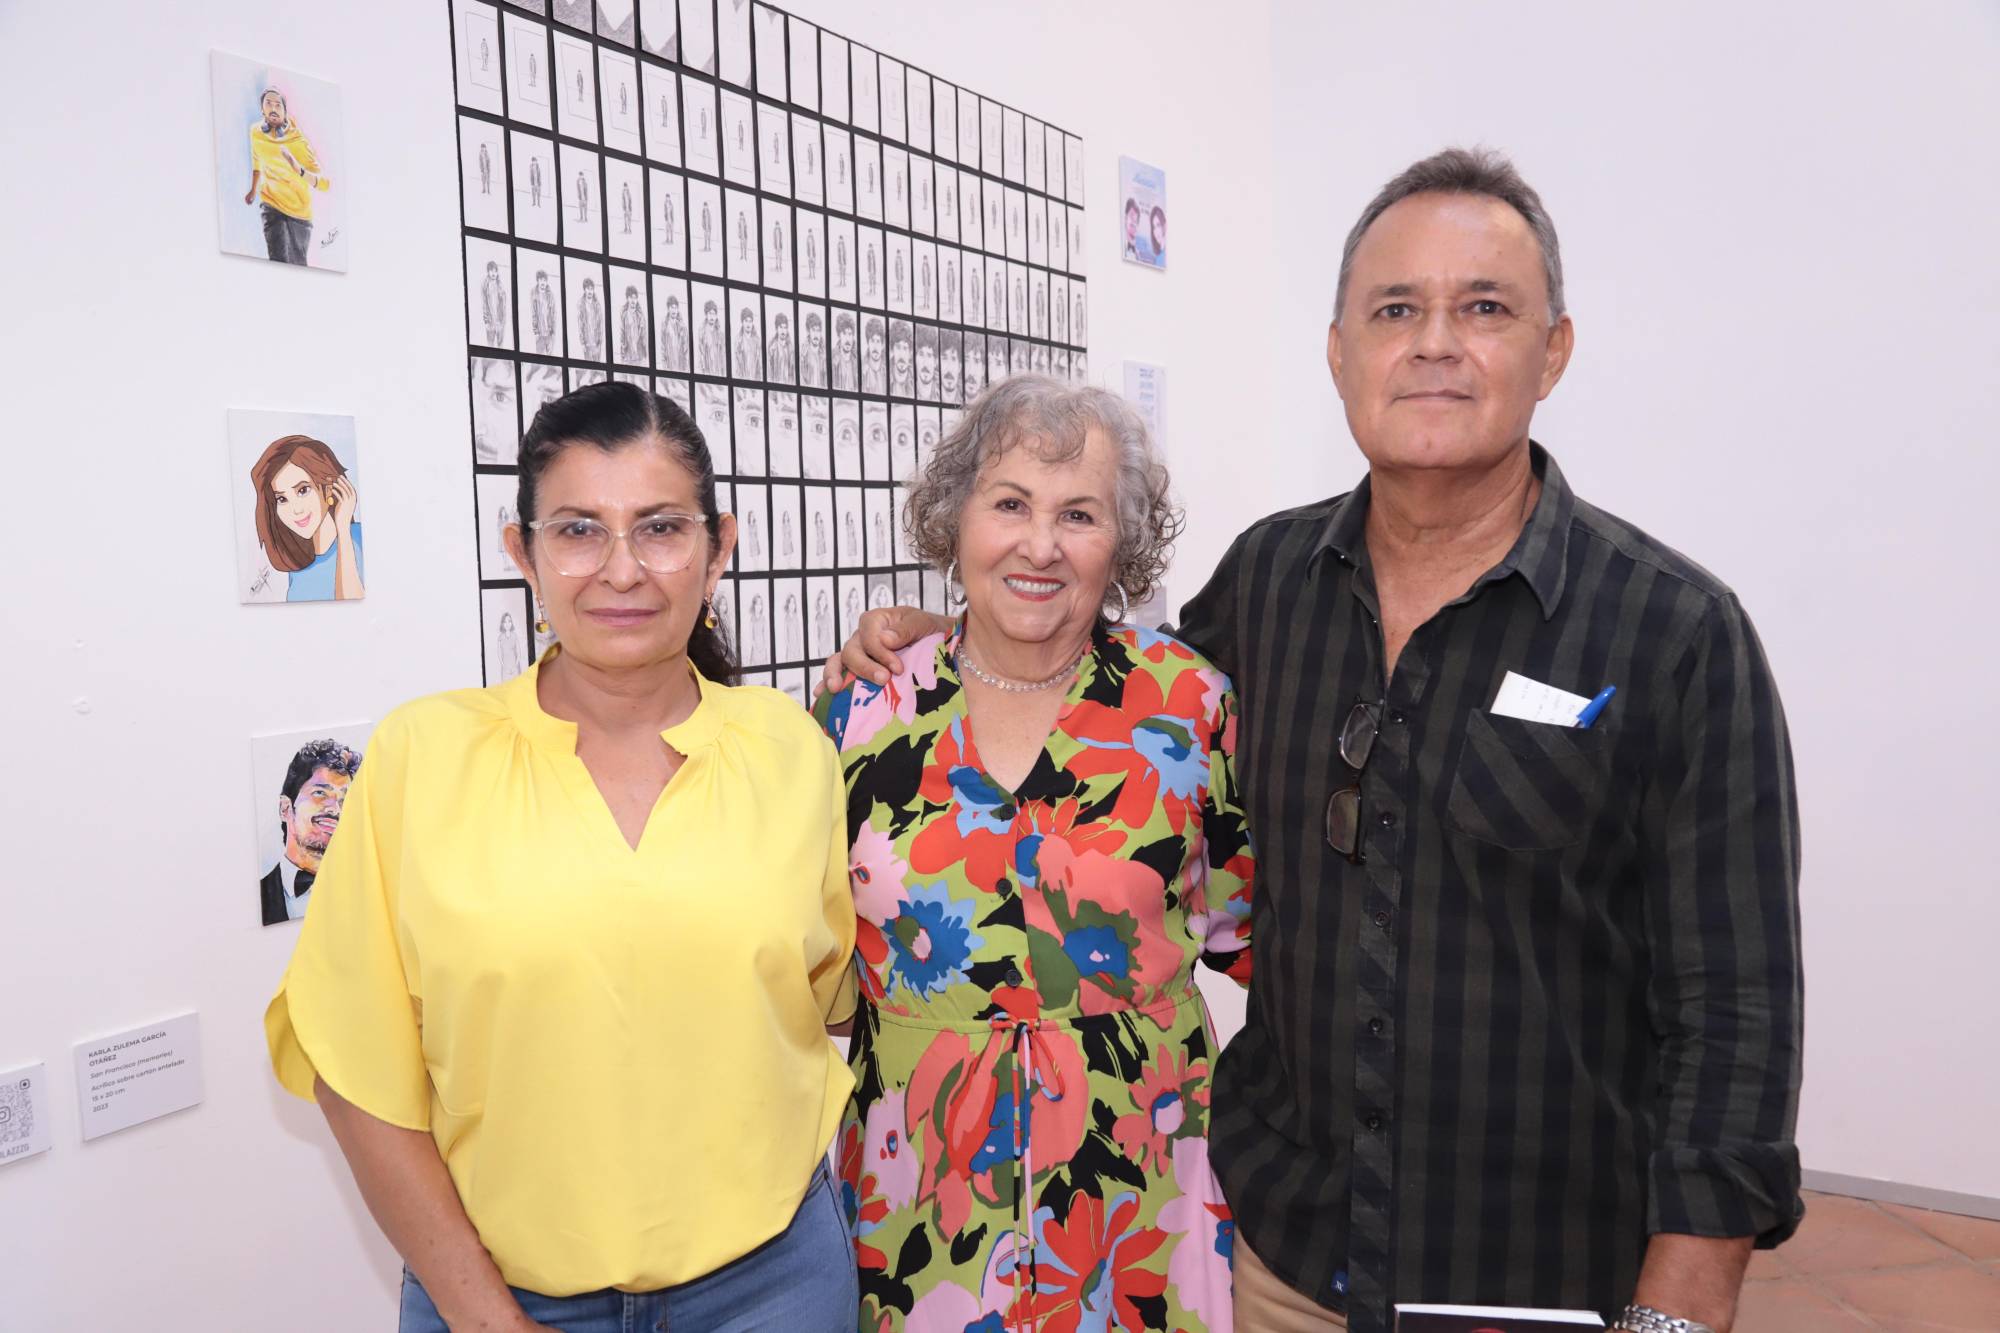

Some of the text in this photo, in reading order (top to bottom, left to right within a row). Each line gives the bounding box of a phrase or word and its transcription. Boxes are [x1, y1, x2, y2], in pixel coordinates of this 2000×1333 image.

[88, 1031, 167, 1059] KARLA ZULEMA GARCÍA
[89, 1071, 104, 1080] San
[104, 1061, 136, 1075] Francisco
[117, 1074, 135, 1084] sobre
[105, 1090, 114, 1098] 20
[115, 1088, 126, 1096] cm
[92, 1103, 109, 1113] 2023
